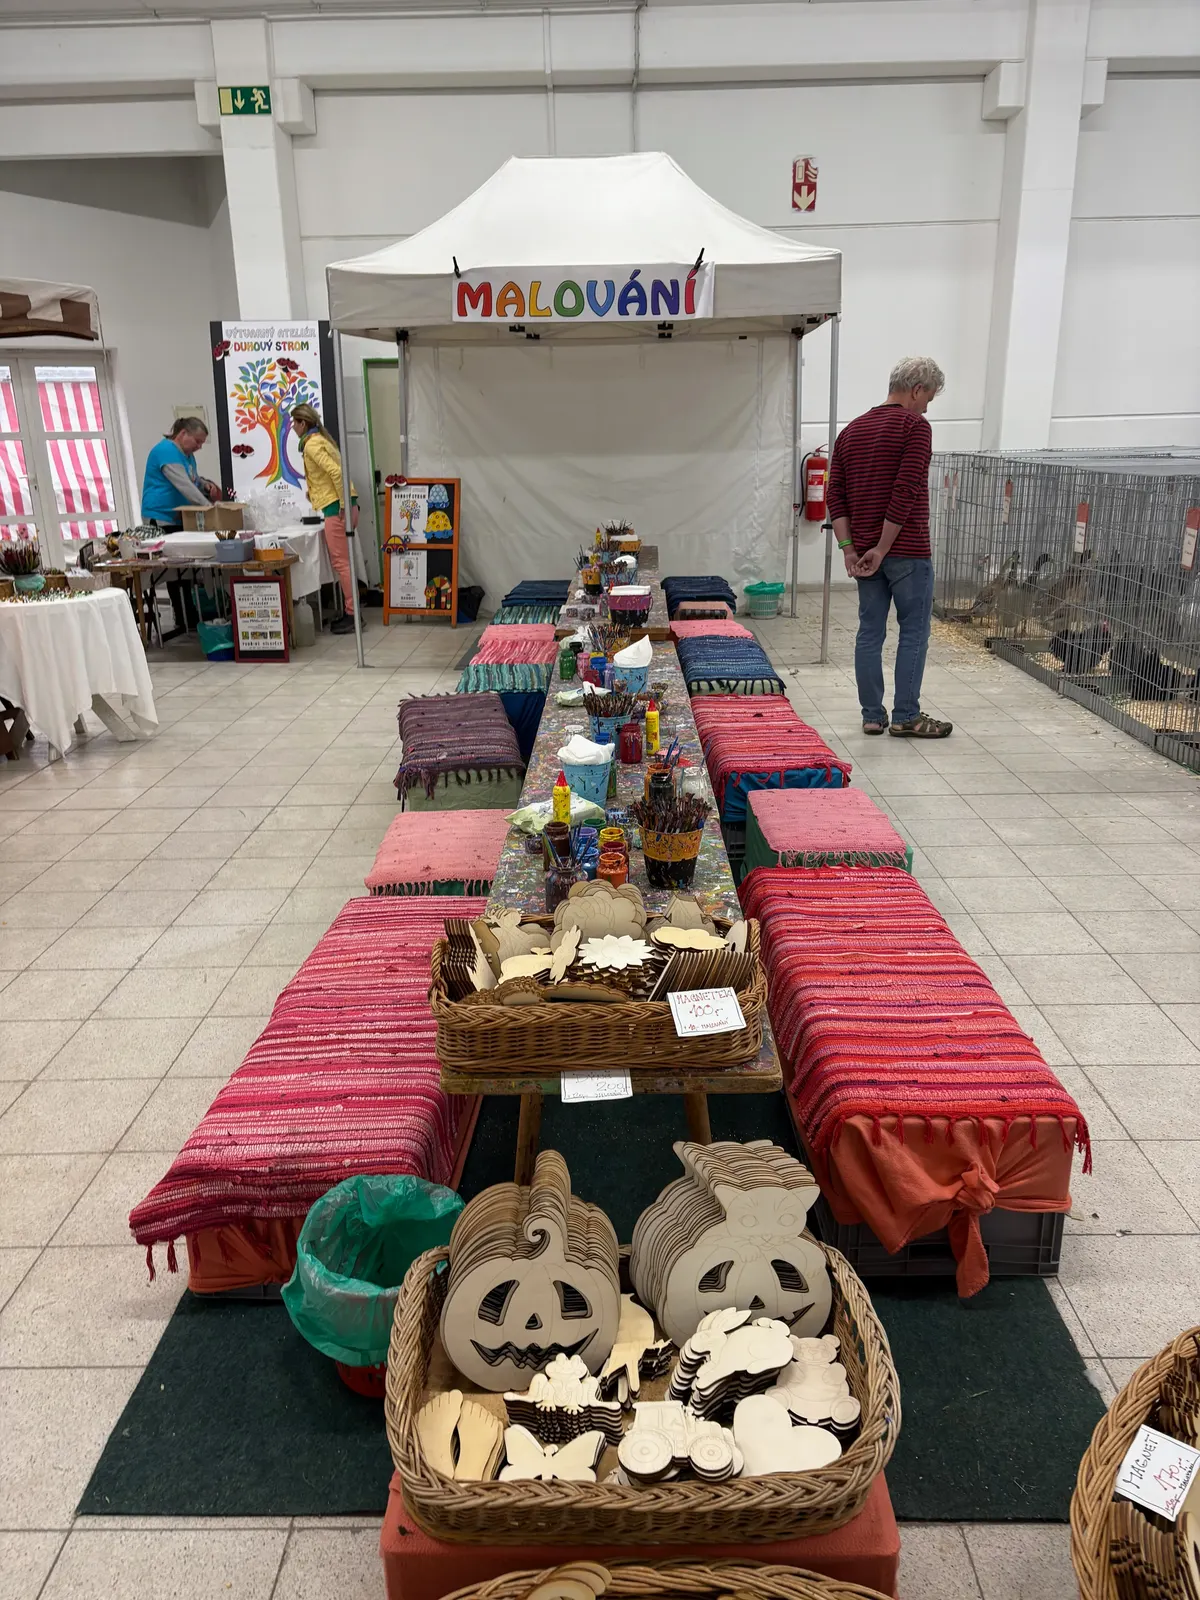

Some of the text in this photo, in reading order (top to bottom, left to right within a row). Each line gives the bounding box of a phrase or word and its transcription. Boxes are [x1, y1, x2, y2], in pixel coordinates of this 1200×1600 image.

[457, 269, 698, 317] MALOVÁNÍ
[234, 339, 309, 352] DUHOVÝ STROM
[1122, 1434, 1158, 1489] MAGNET
